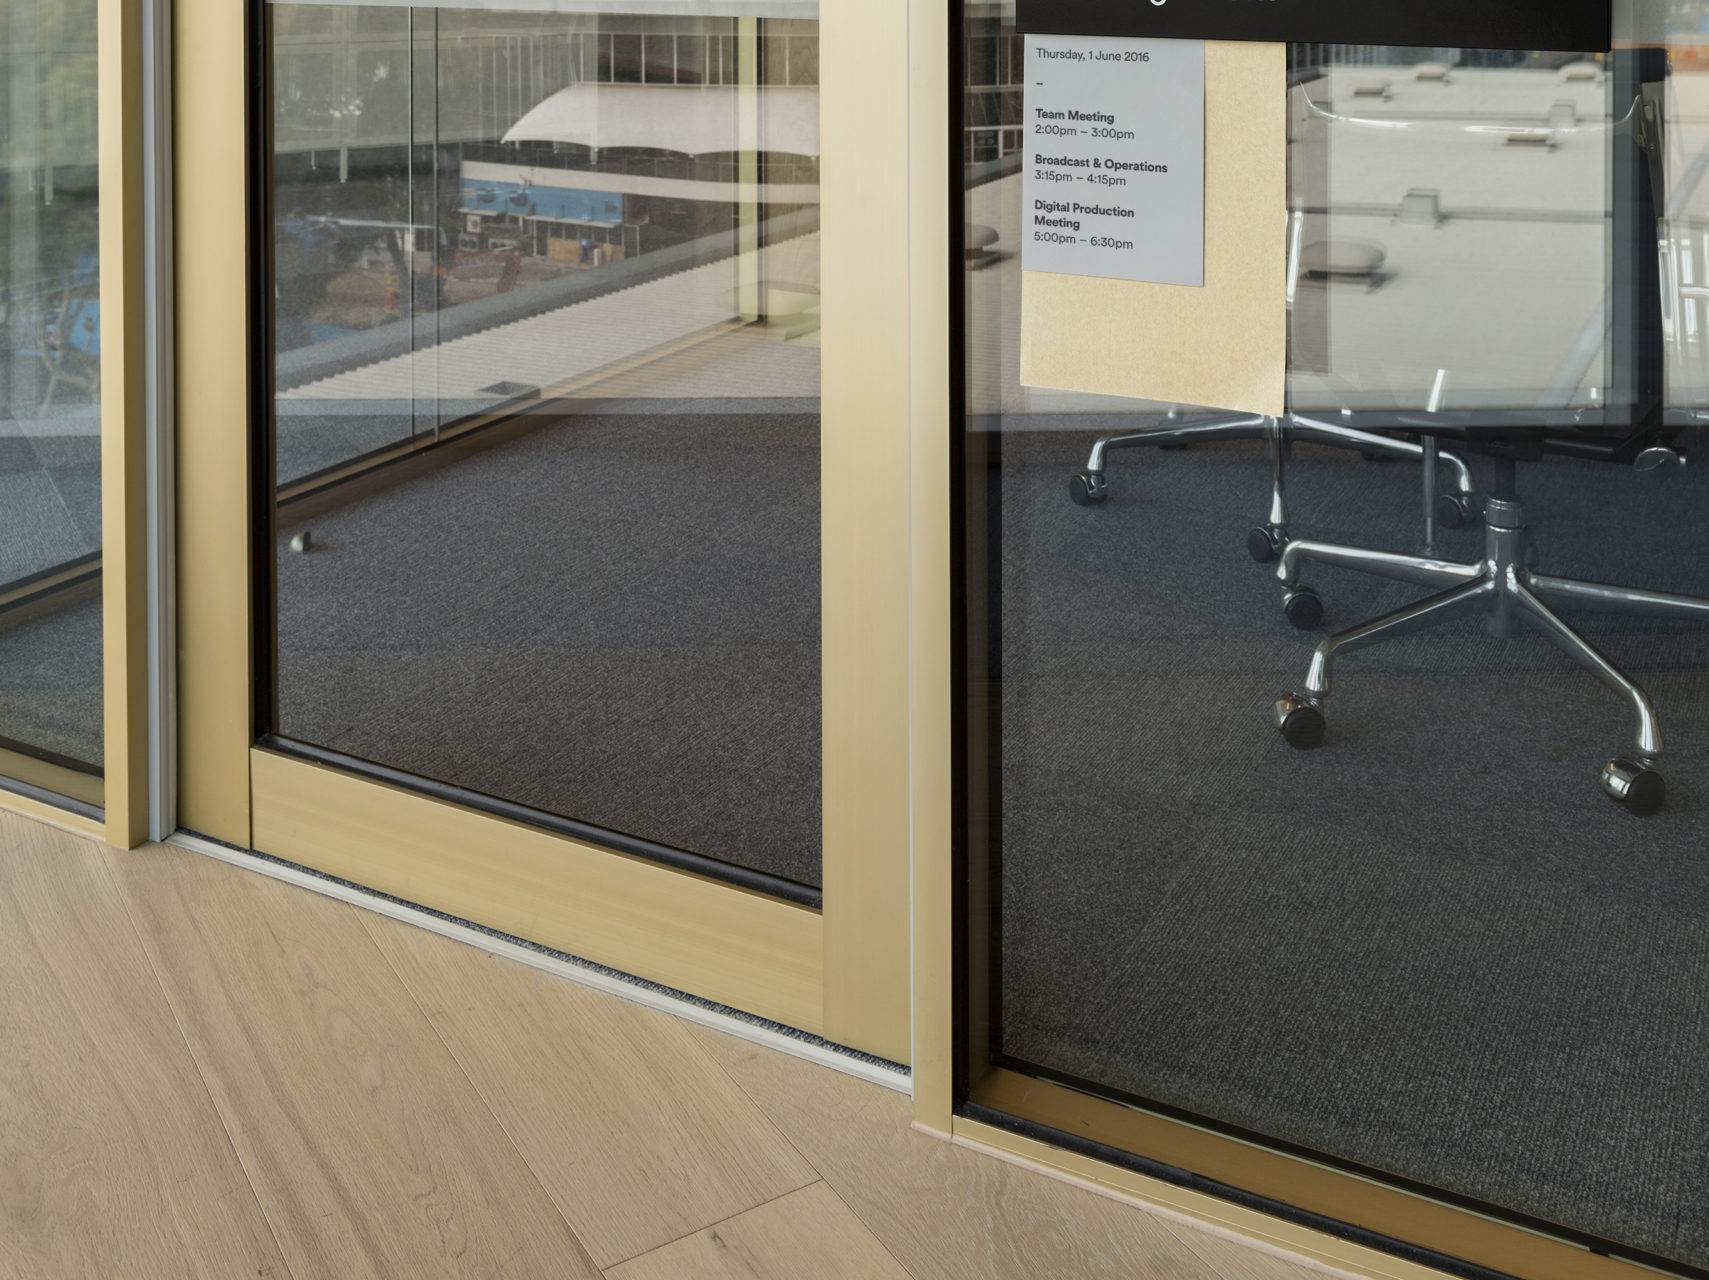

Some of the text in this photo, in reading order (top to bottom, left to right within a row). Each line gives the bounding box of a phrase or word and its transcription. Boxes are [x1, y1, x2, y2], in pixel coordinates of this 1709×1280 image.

[1036, 48, 1150, 62] Thursday, 1 June 2016
[1035, 108, 1115, 125] Team Meeting
[1035, 124, 1077, 137] 2:00pm
[1091, 127, 1135, 141] 3:00pm
[1035, 154, 1168, 173] Broadcast & Operations
[1034, 170, 1073, 183] 3:15pm
[1086, 173, 1126, 187] 4:15pm
[1034, 200, 1135, 217] Digital Production
[1034, 215, 1081, 231] Meeting
[1034, 231, 1076, 245] 5:00pm
[1090, 236, 1134, 250] 6:30pm
